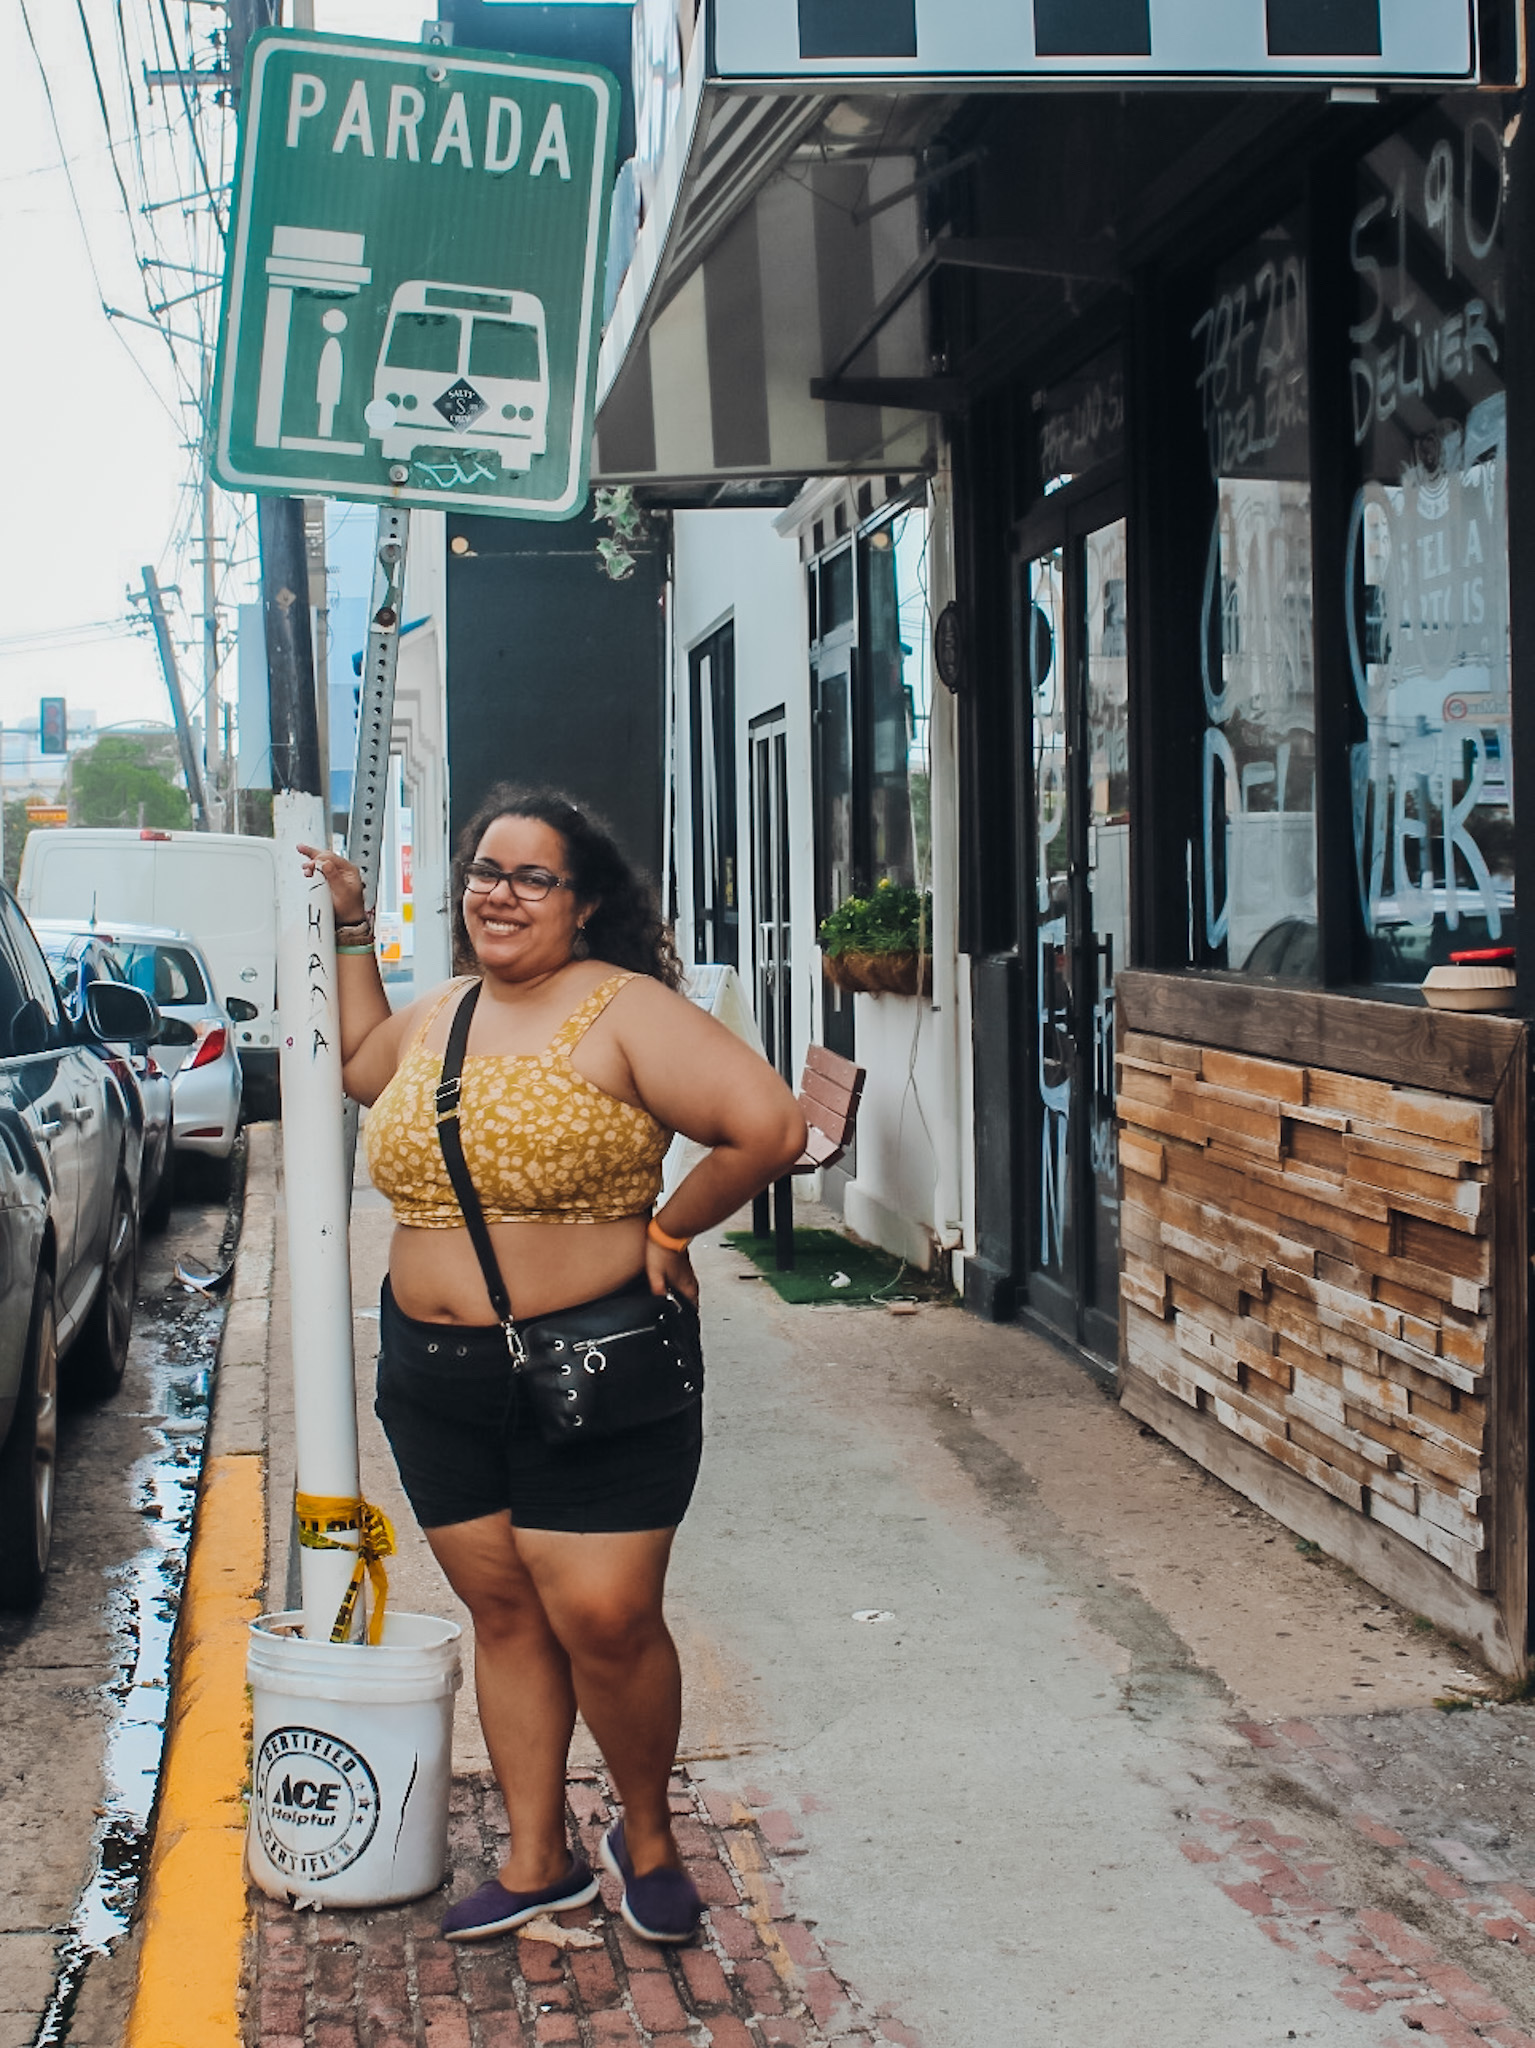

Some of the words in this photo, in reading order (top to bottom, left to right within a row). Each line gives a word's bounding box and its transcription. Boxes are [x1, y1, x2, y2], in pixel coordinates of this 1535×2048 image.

[286, 72, 571, 180] PARADA
[1349, 292, 1506, 446] DELIVER
[264, 1734, 357, 1773] CERTIFIED
[273, 1774, 341, 1811] ACE
[271, 1807, 336, 1826] Helpful
